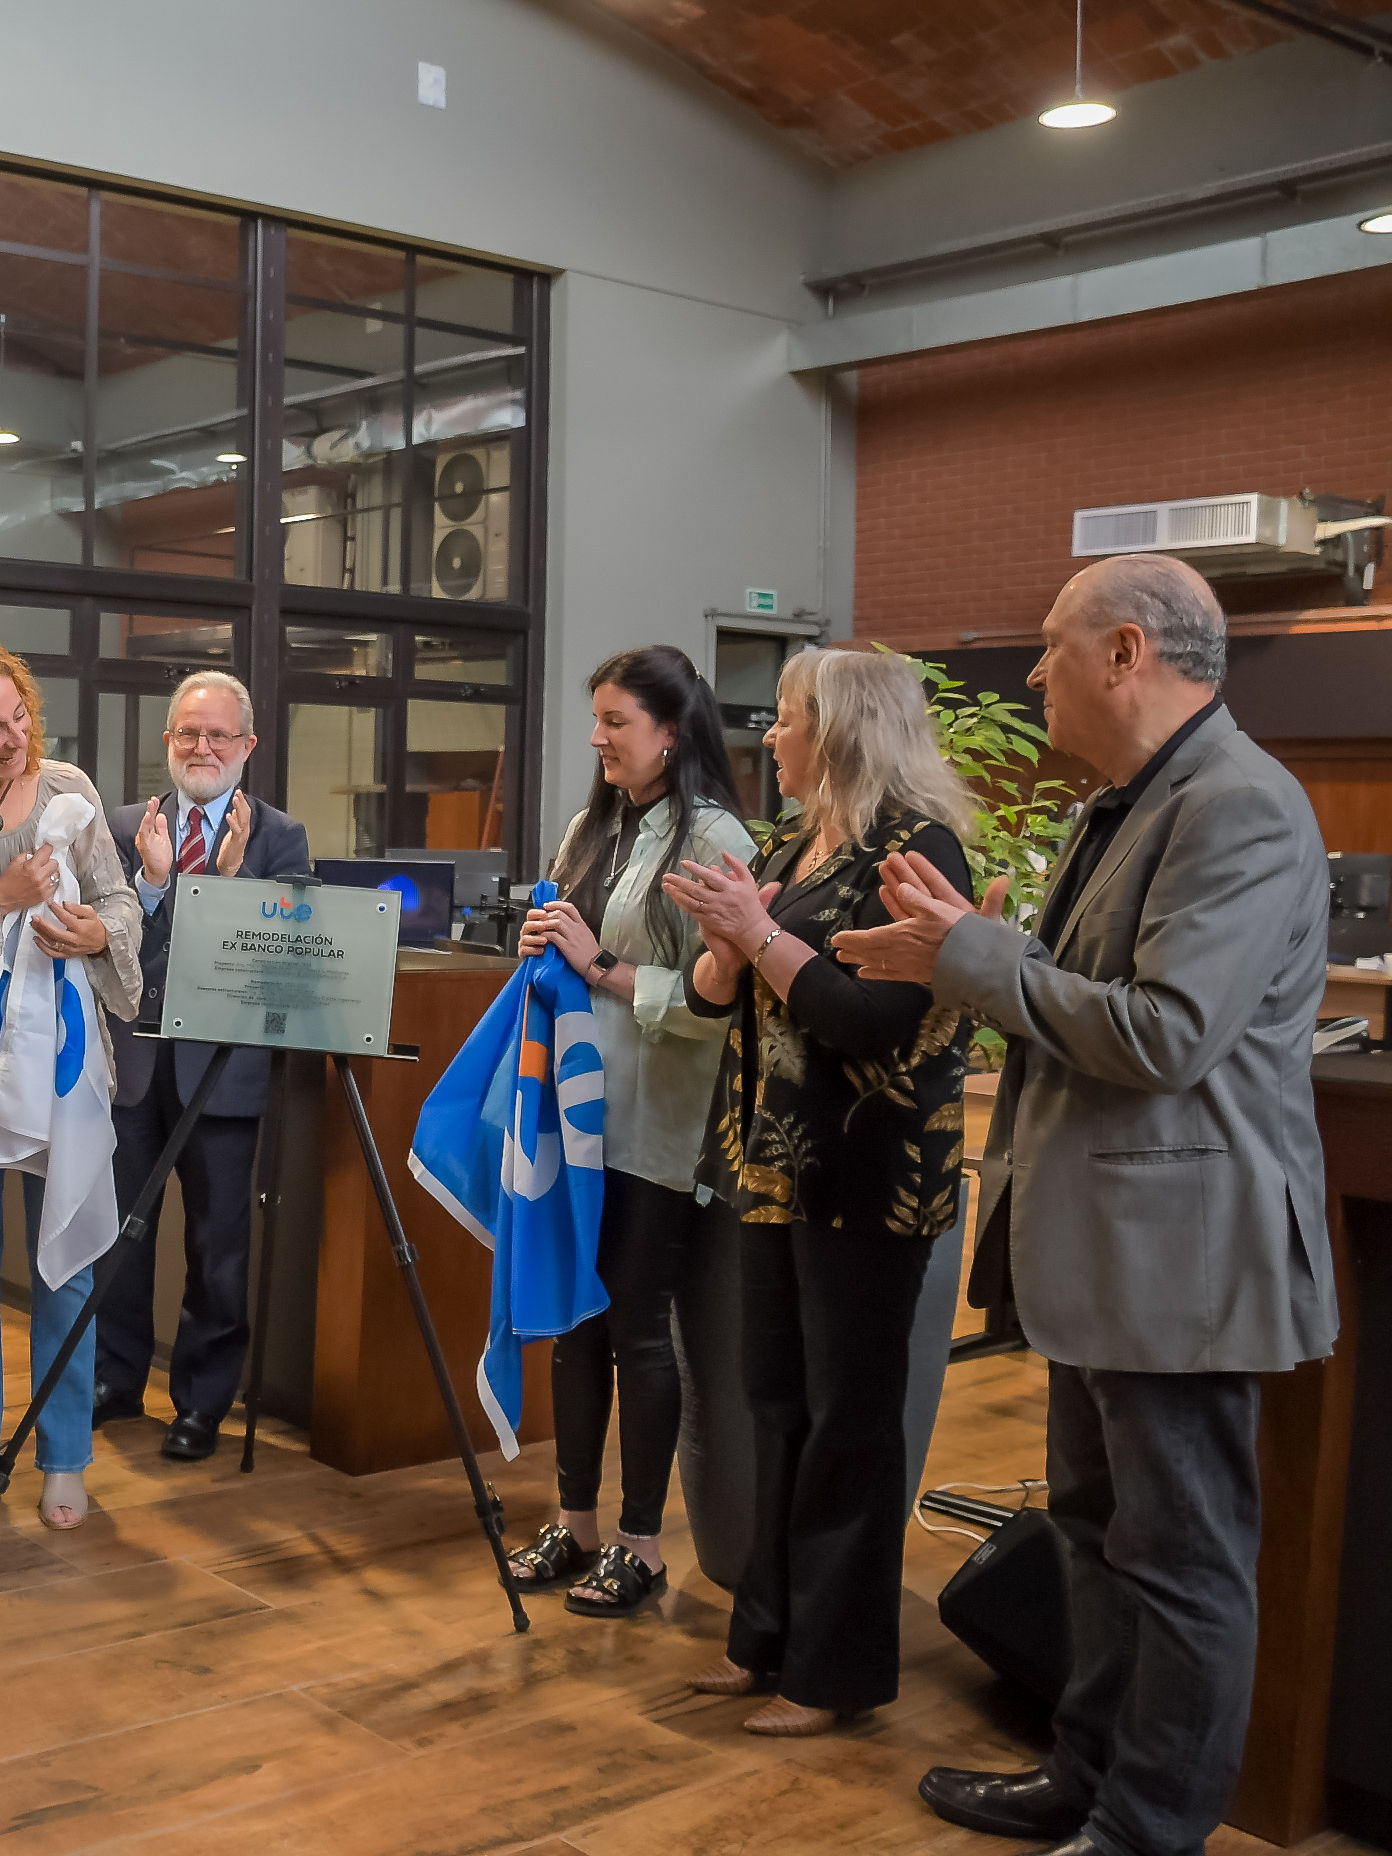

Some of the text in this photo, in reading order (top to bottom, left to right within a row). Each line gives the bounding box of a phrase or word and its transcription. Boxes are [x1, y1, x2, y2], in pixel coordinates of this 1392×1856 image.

[235, 930, 334, 946] REMODELACIÓN
[222, 940, 345, 959] EX BANCO POPULAR
